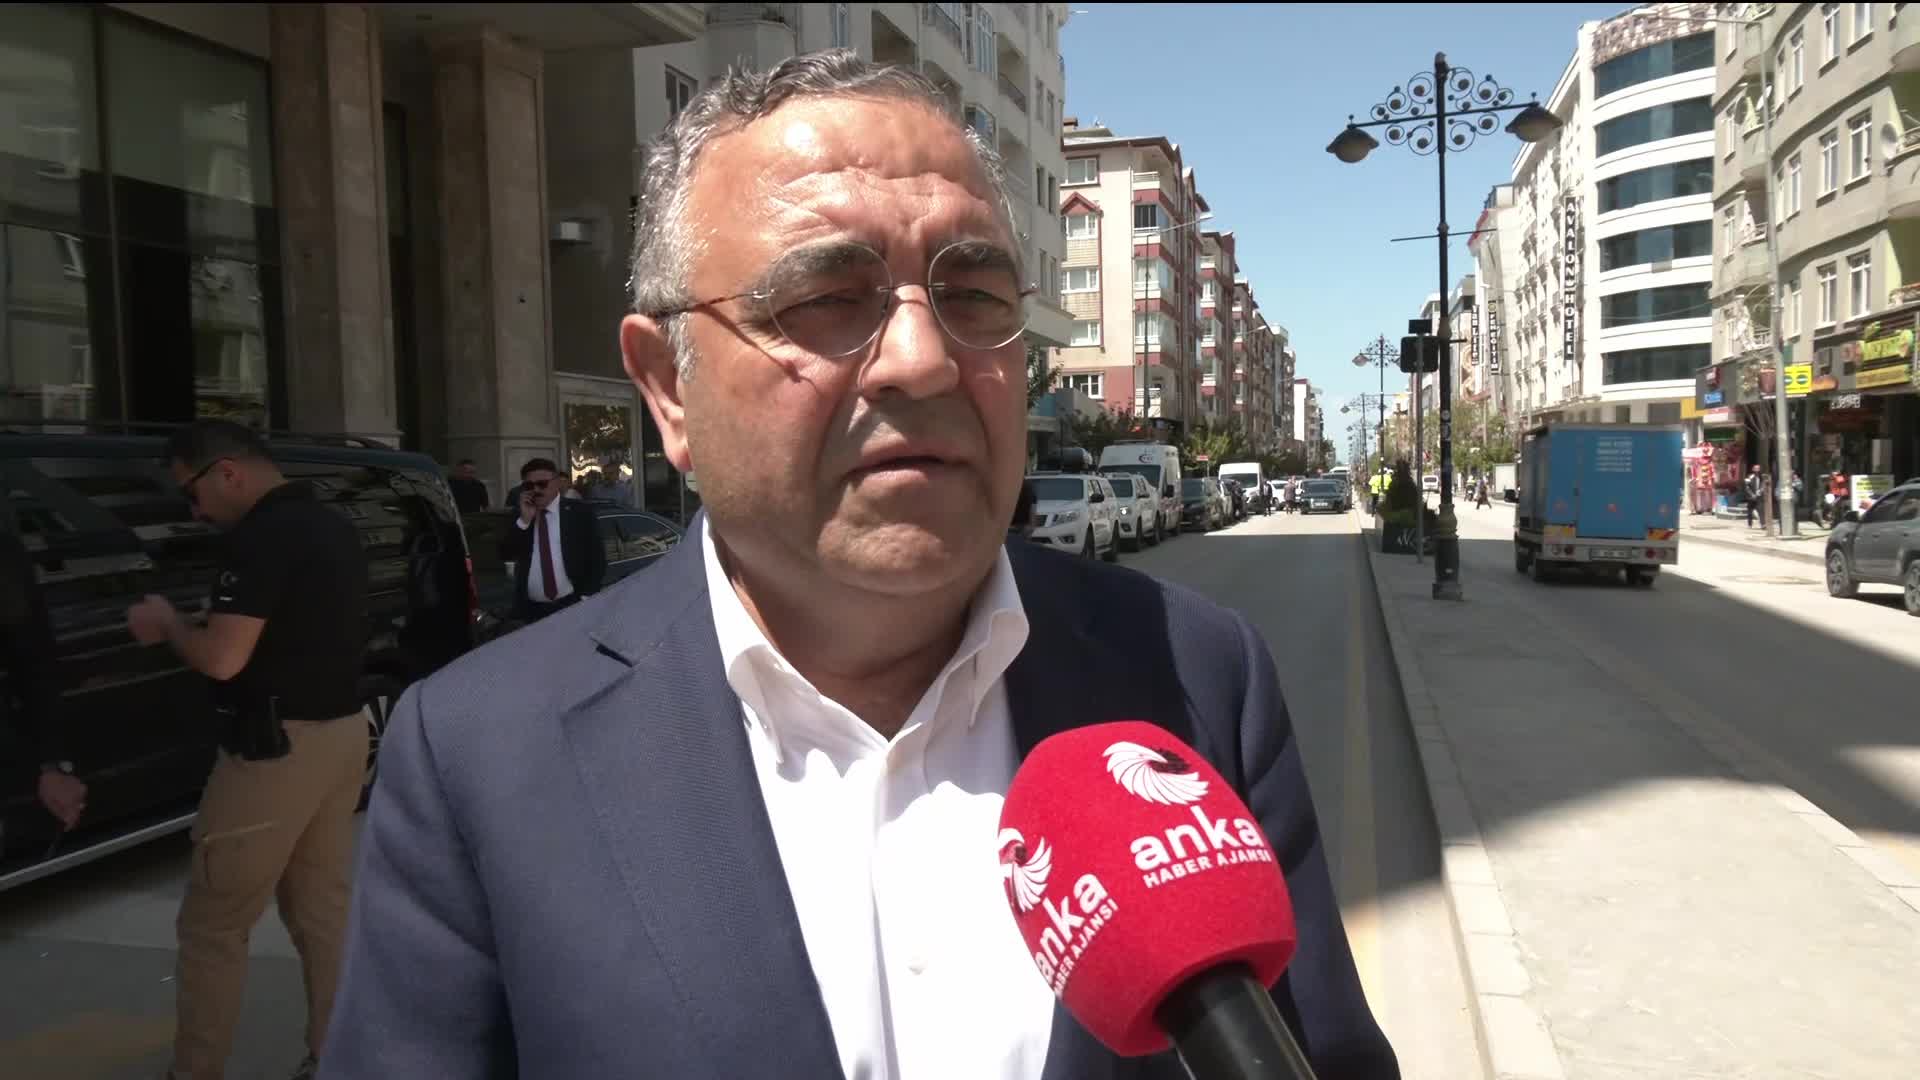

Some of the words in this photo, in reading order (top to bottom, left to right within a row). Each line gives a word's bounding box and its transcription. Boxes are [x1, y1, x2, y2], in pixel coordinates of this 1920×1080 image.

[1566, 202, 1575, 276] AVALON
[1566, 294, 1575, 355] HOTEL
[1130, 805, 1265, 871] anka
[1142, 855, 1213, 889] HABER
[1216, 848, 1272, 867] AJANSI
[1035, 873, 1108, 985] anka
[1071, 898, 1119, 960] AJANSI
